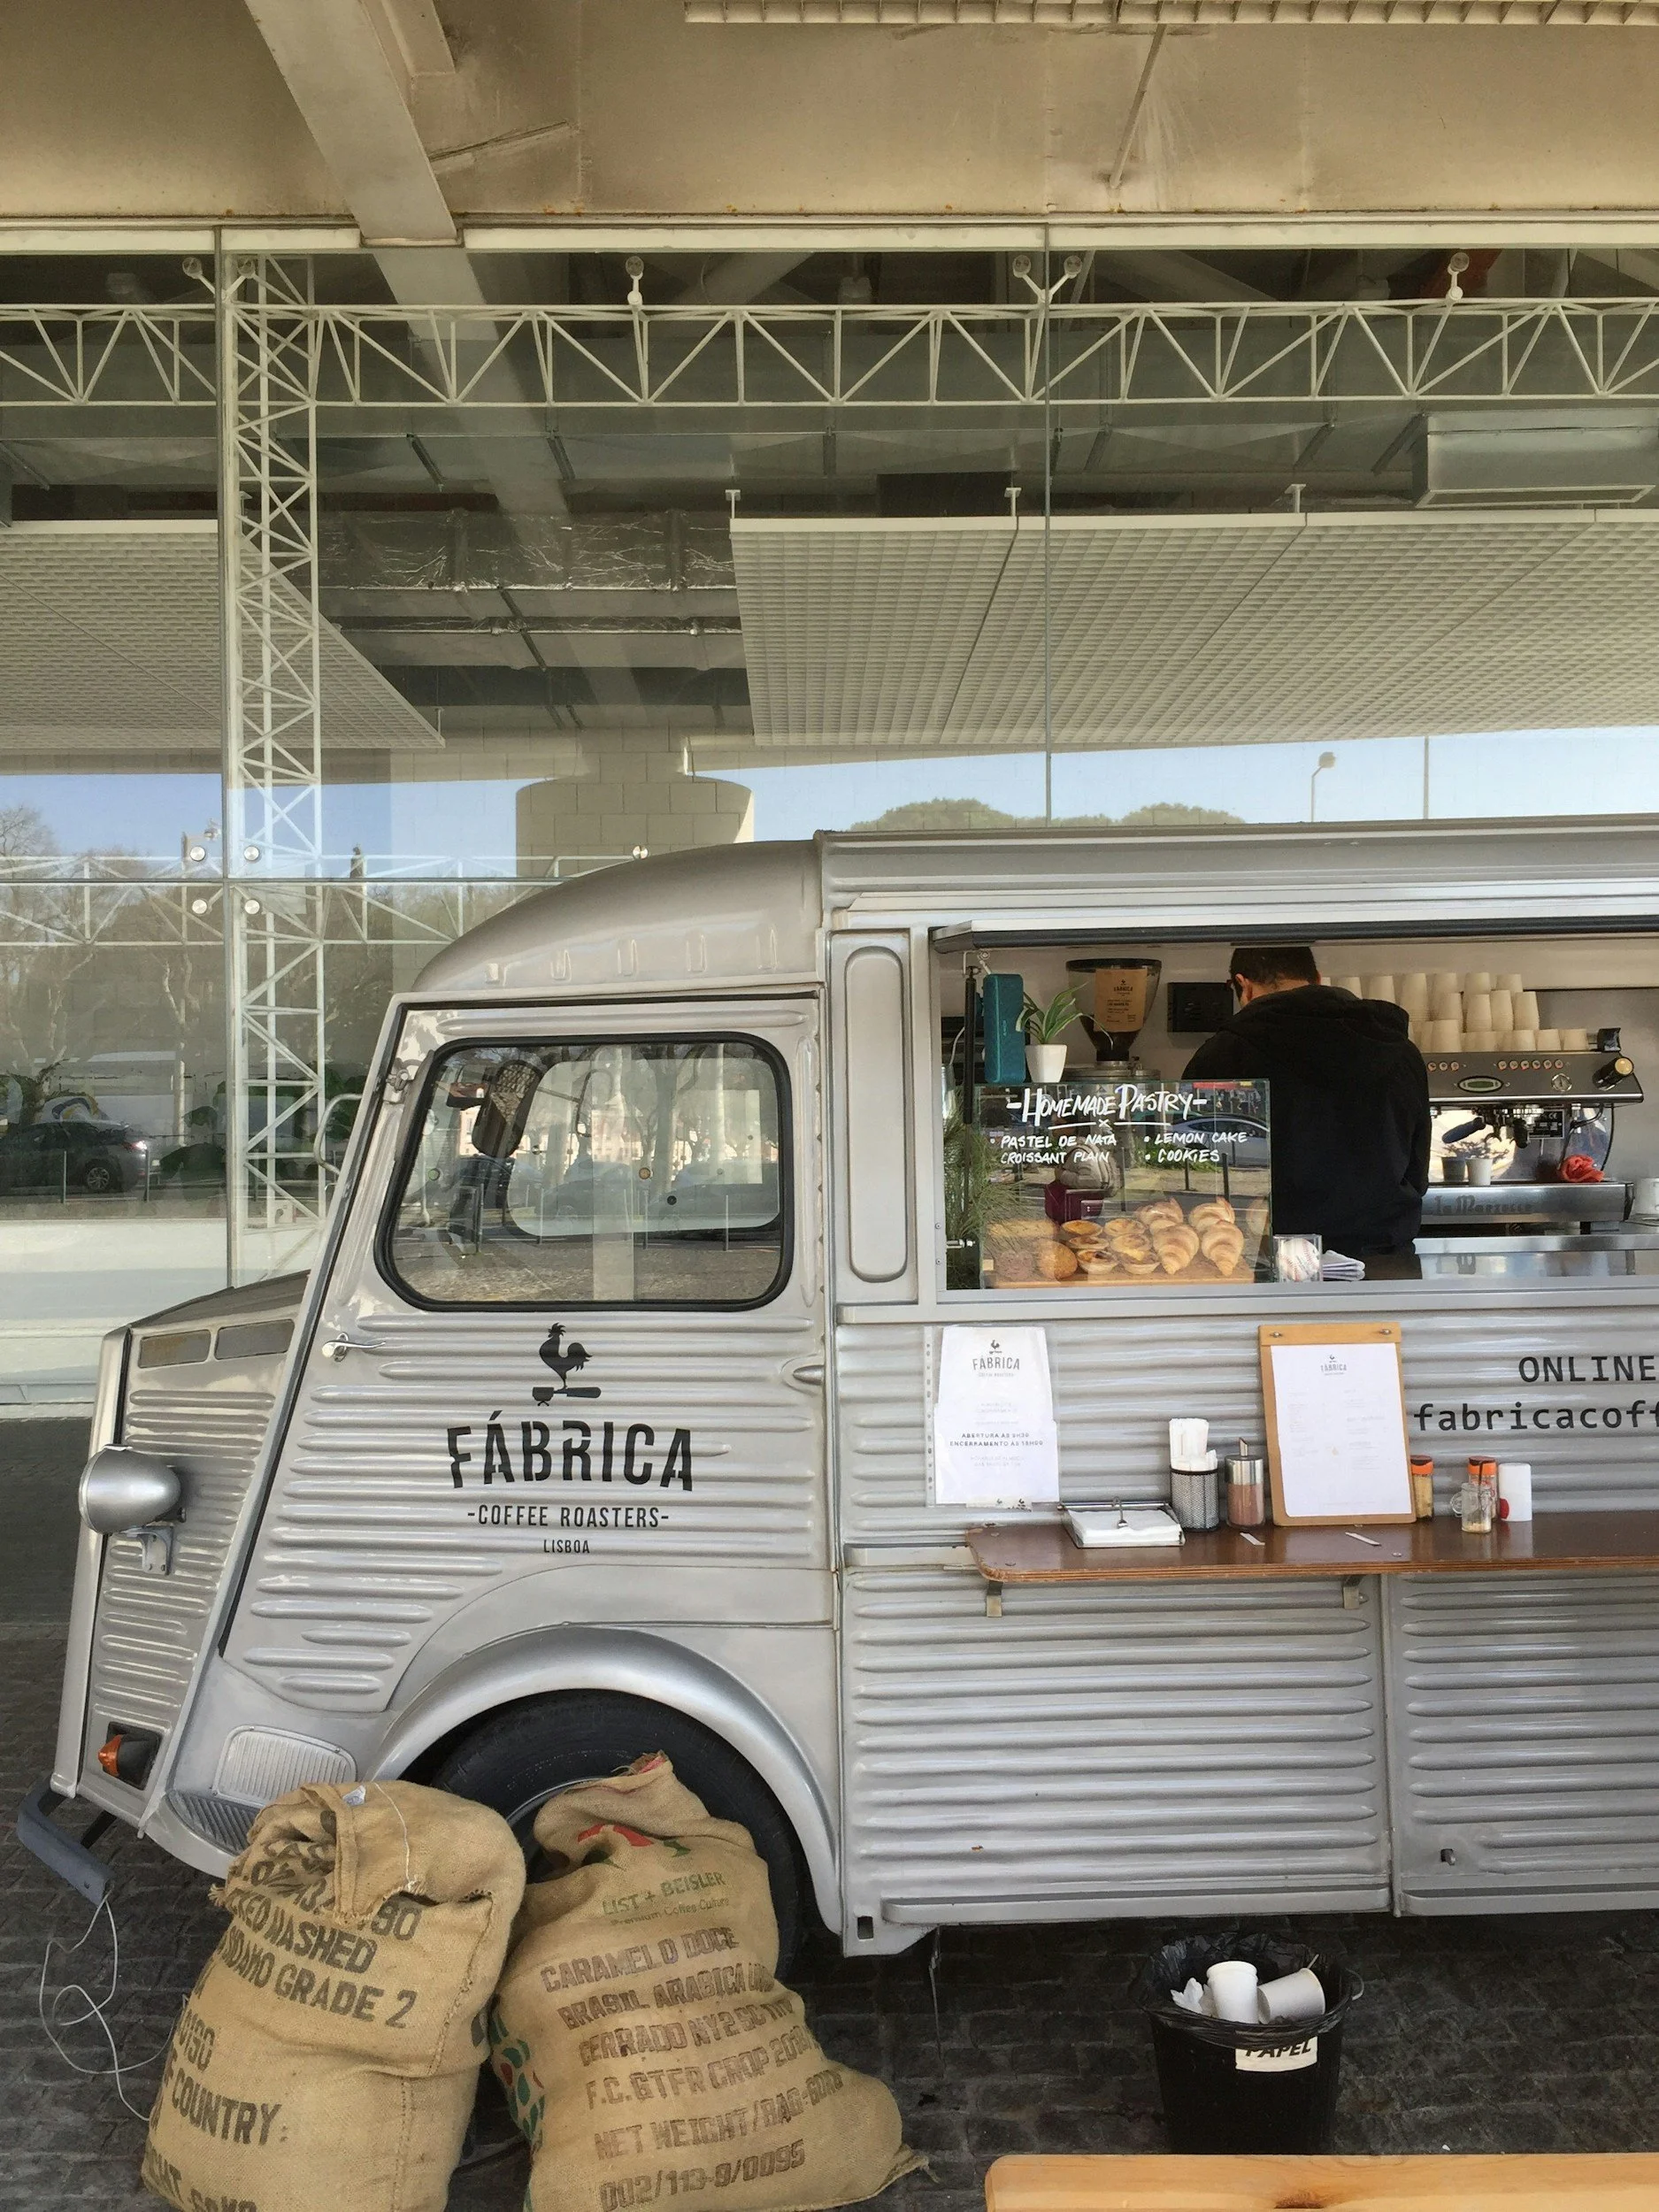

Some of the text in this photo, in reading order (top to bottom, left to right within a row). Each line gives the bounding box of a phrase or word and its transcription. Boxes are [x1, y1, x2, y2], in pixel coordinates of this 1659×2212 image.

[1001, 1134, 1118, 1148] PASTEL DE NATA
[1154, 1132, 1248, 1146] LEMON CAKE
[1157, 1148, 1221, 1164] COOKIES
[1000, 1151, 1110, 1164] CROISSANT PLAIN
[972, 1355, 1020, 1371] FÁBRICA
[1518, 1355, 1656, 1383] ONLINE
[447, 1409, 694, 1492] FÁBRICA
[543, 1540, 590, 1554] LISBOA
[602, 1893, 640, 1916] LIST
[660, 1871, 727, 1897] BEISLER
[265, 1906, 378, 1974] WASHED
[680, 1926, 740, 1959] DOCE
[274, 1962, 385, 2023] GRADE
[384, 1988, 419, 2029] 2
[557, 1989, 651, 2031] BRASIL
[652, 1962, 747, 2008] ARABICA
[578, 2021, 688, 2067] CERRADO
[707, 2046, 769, 2090] CROP
[594, 2124, 644, 2161] NET
